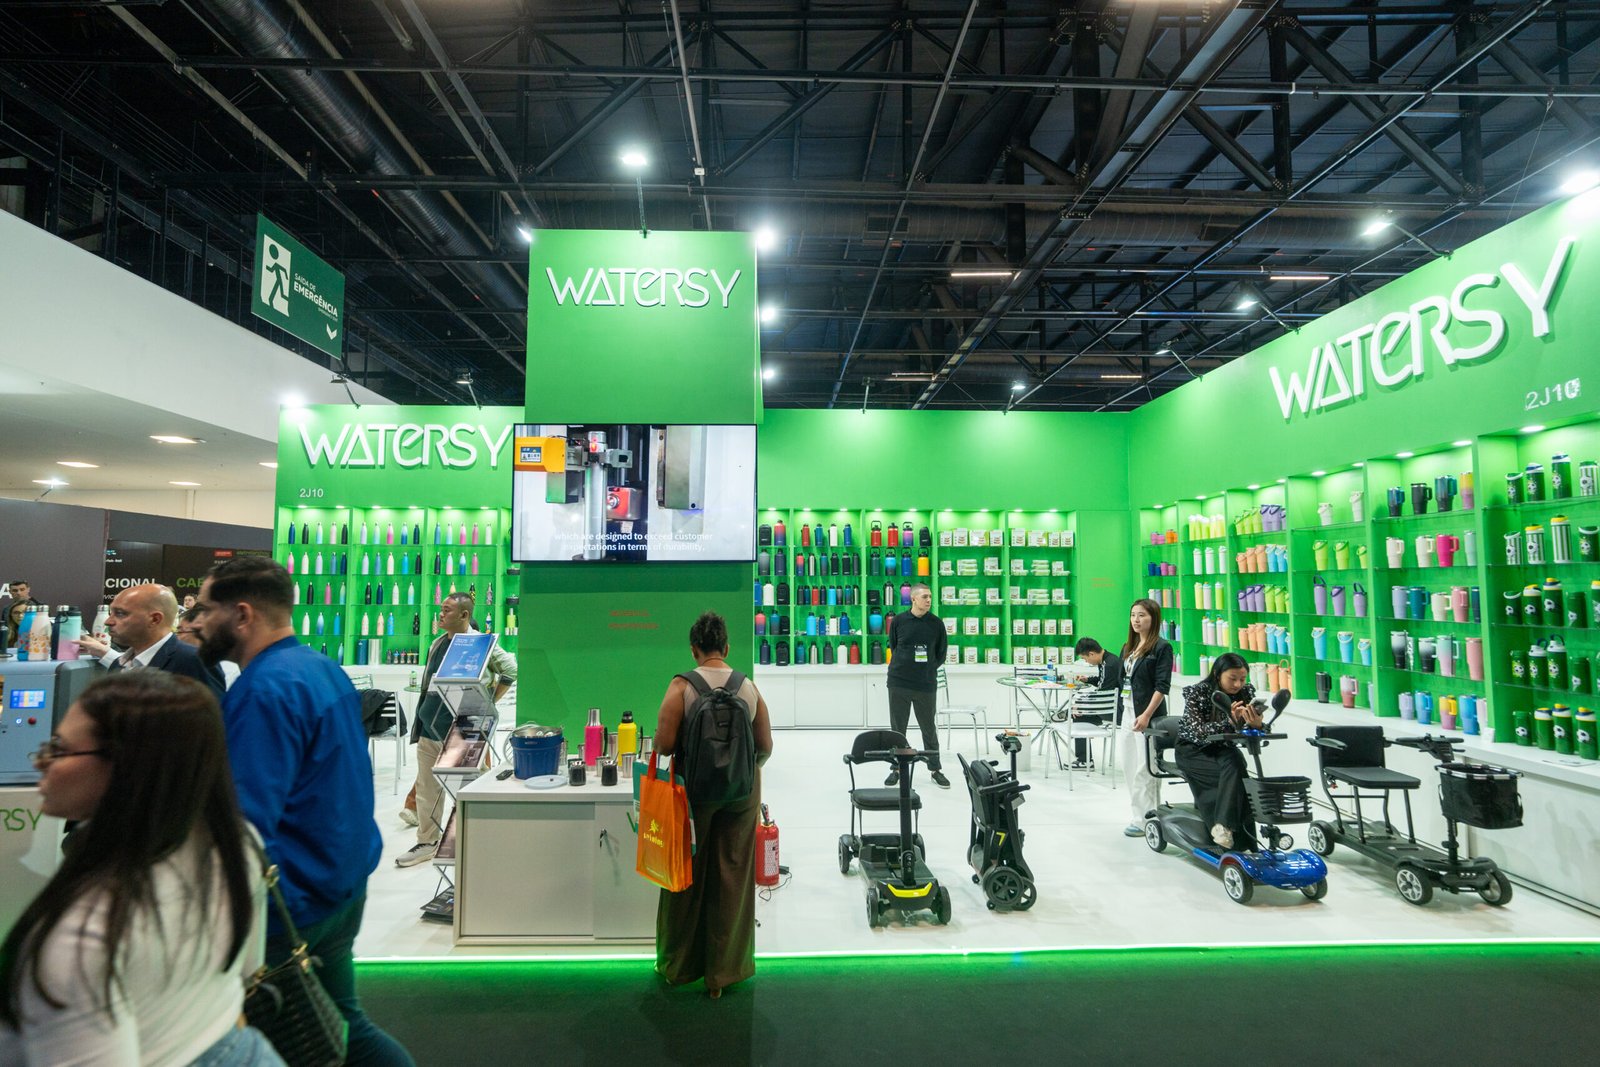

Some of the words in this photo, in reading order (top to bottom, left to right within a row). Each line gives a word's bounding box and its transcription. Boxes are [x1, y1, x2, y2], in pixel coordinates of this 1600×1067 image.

[294, 281, 338, 317] EMERGÊNCIA
[300, 488, 323, 498] 2J10
[595, 531, 632, 542] designed
